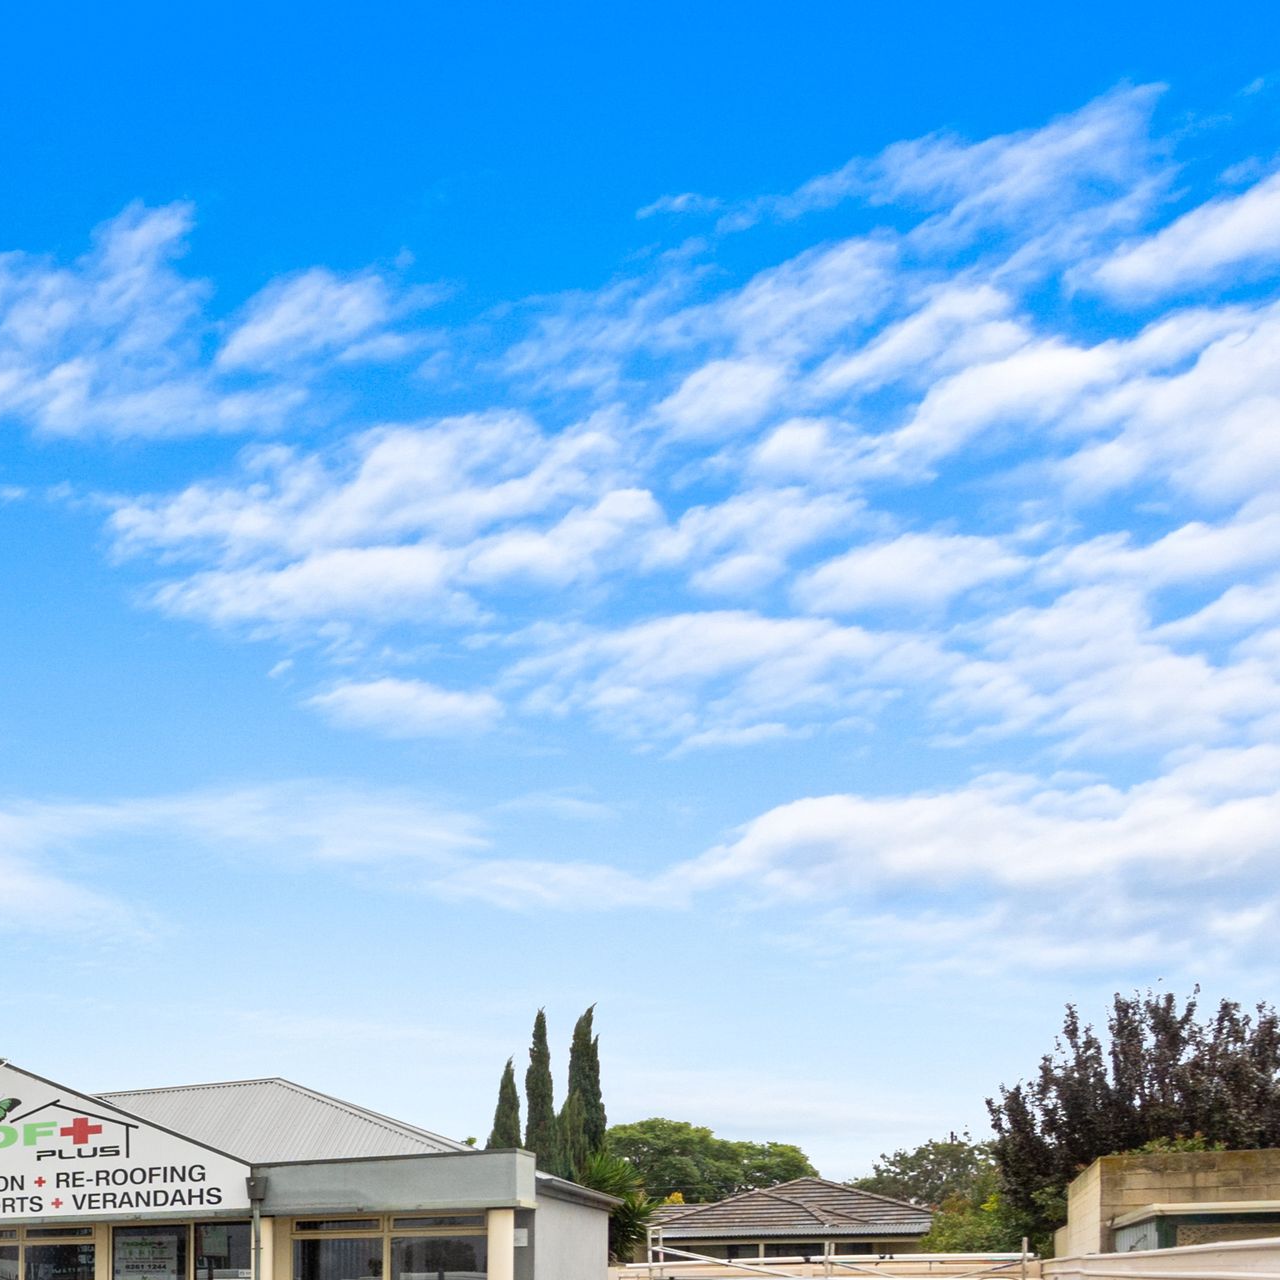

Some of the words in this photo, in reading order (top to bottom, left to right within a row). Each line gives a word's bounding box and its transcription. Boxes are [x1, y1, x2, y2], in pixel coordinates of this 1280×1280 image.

[36, 1145, 121, 1161] PLUS
[56, 1164, 206, 1189] RE-ROOFING
[72, 1187, 222, 1210] VERANDAHS
